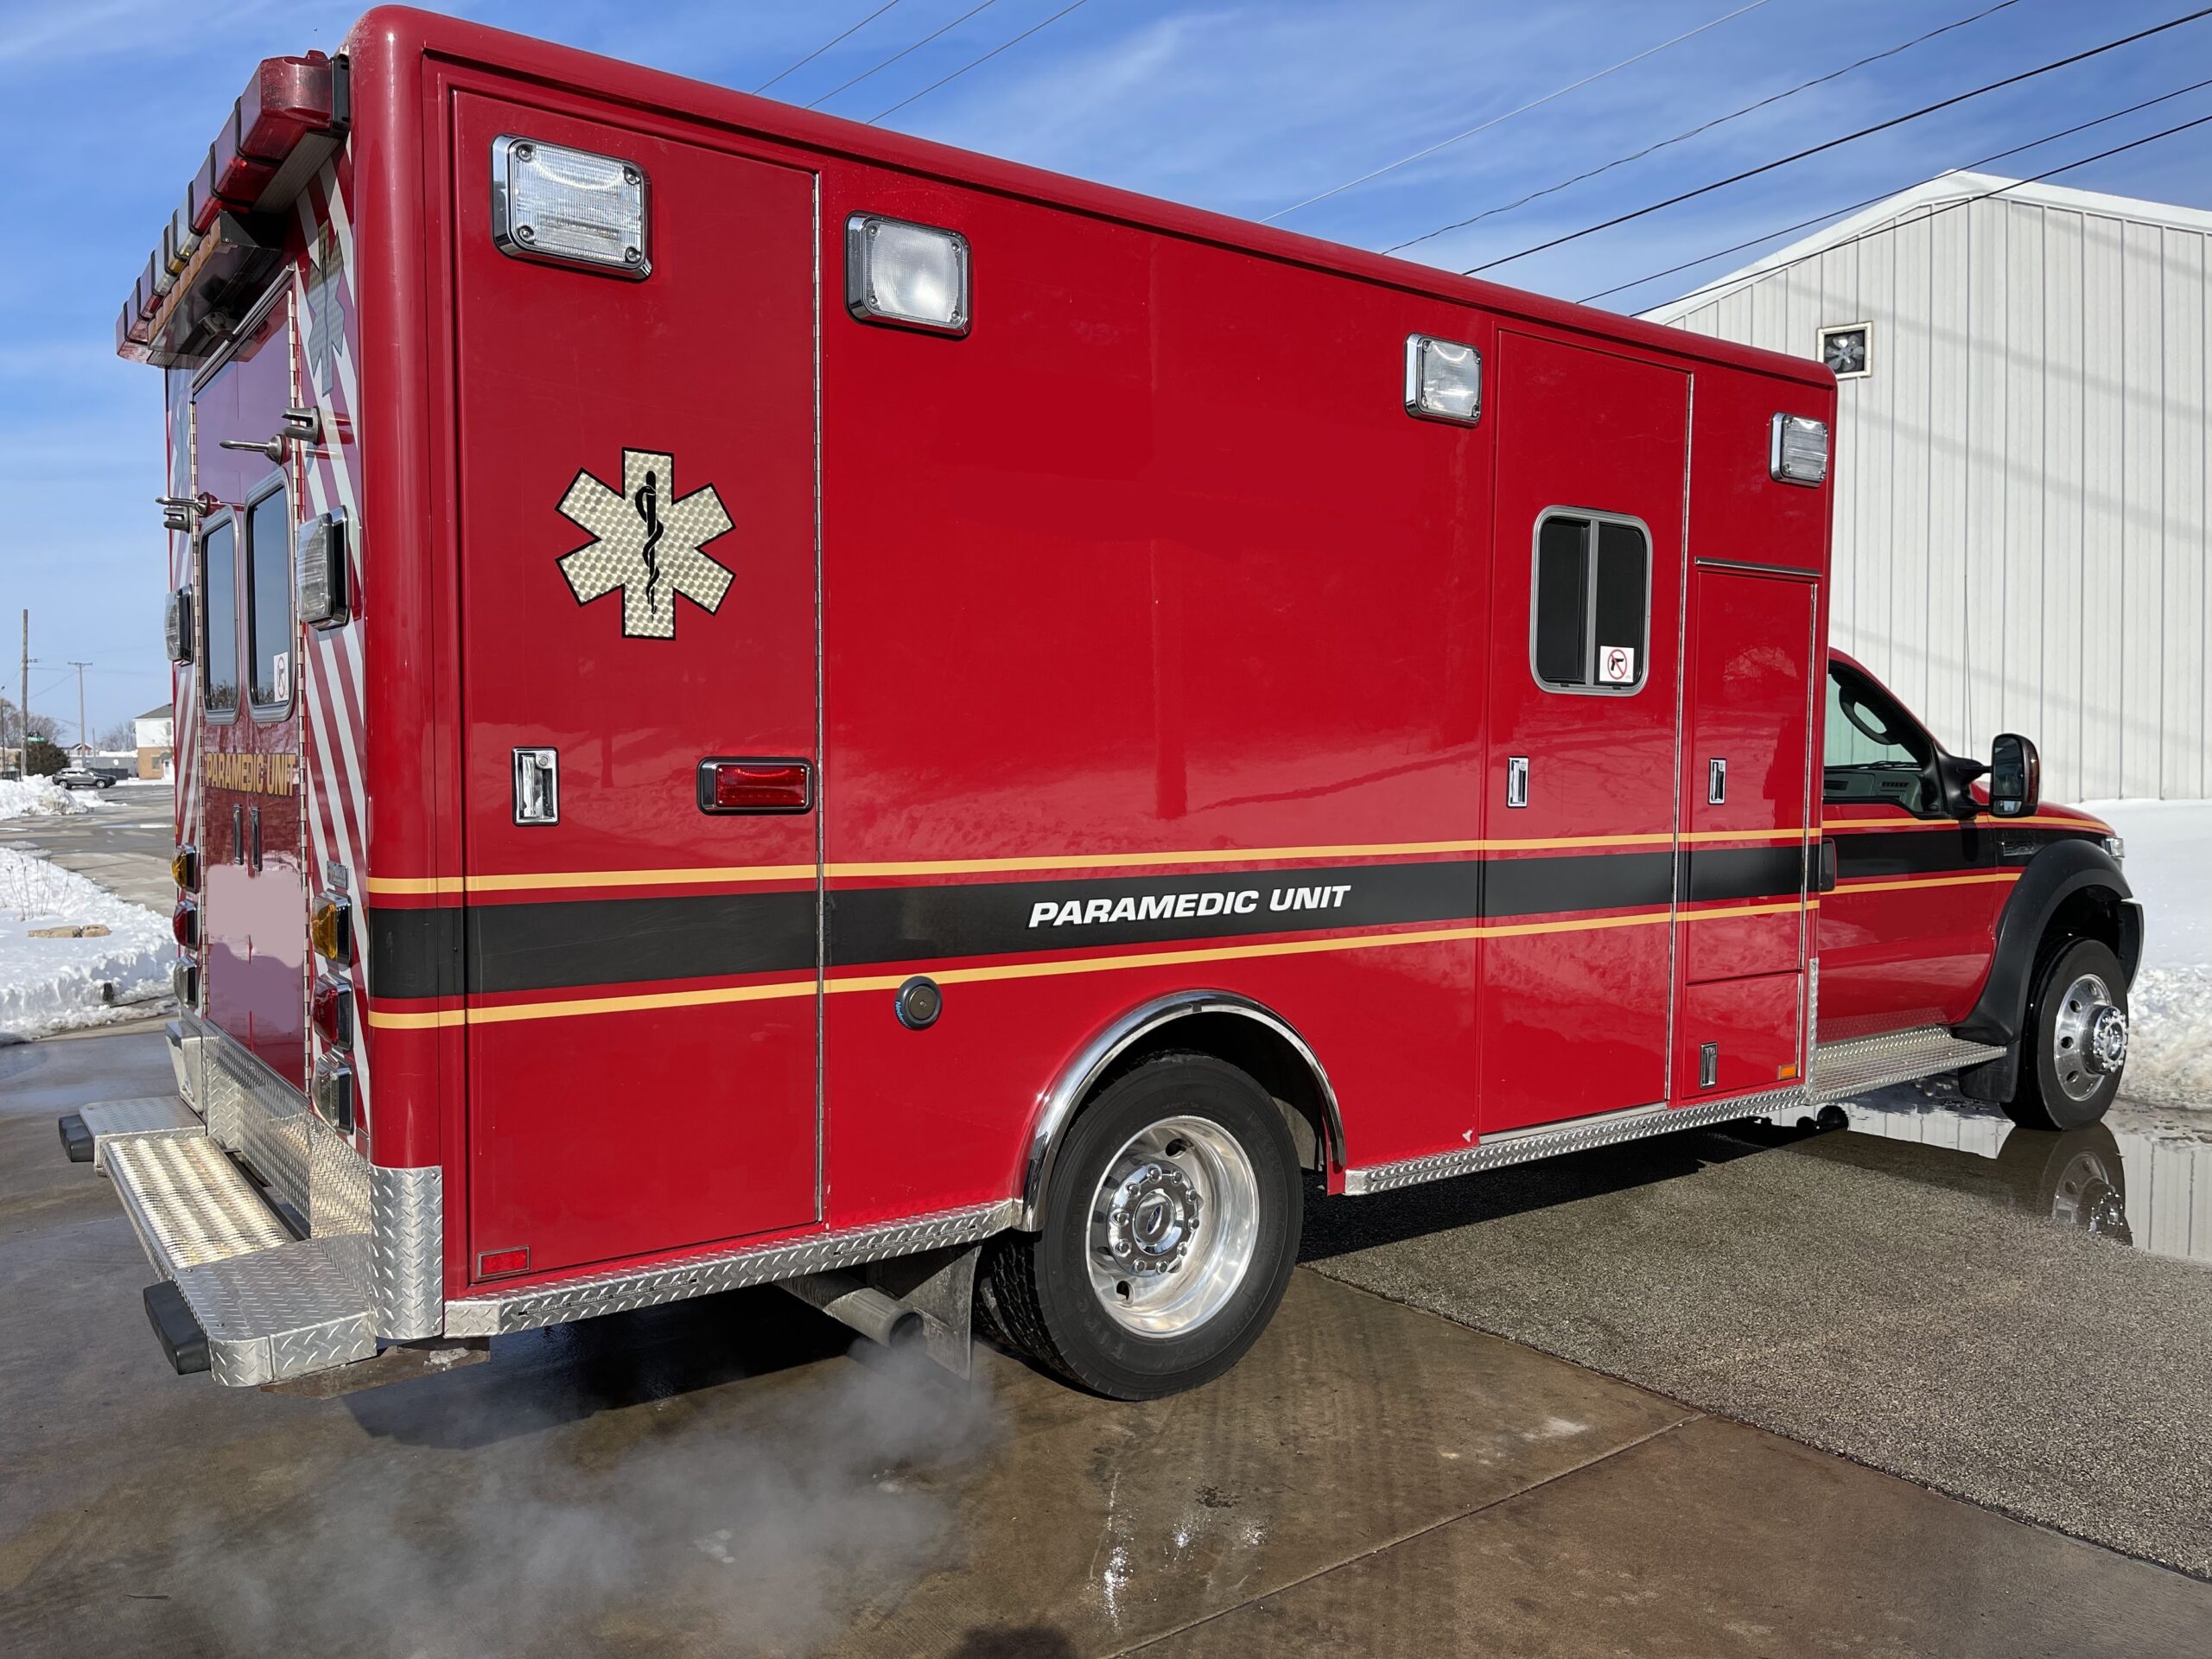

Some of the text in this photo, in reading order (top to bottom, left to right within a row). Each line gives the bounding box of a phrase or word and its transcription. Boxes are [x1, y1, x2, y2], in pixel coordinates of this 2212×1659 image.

[207, 753, 296, 796] PARAMEDIC UNIT
[1028, 885, 1351, 928] PARAMEDIC UNIT
